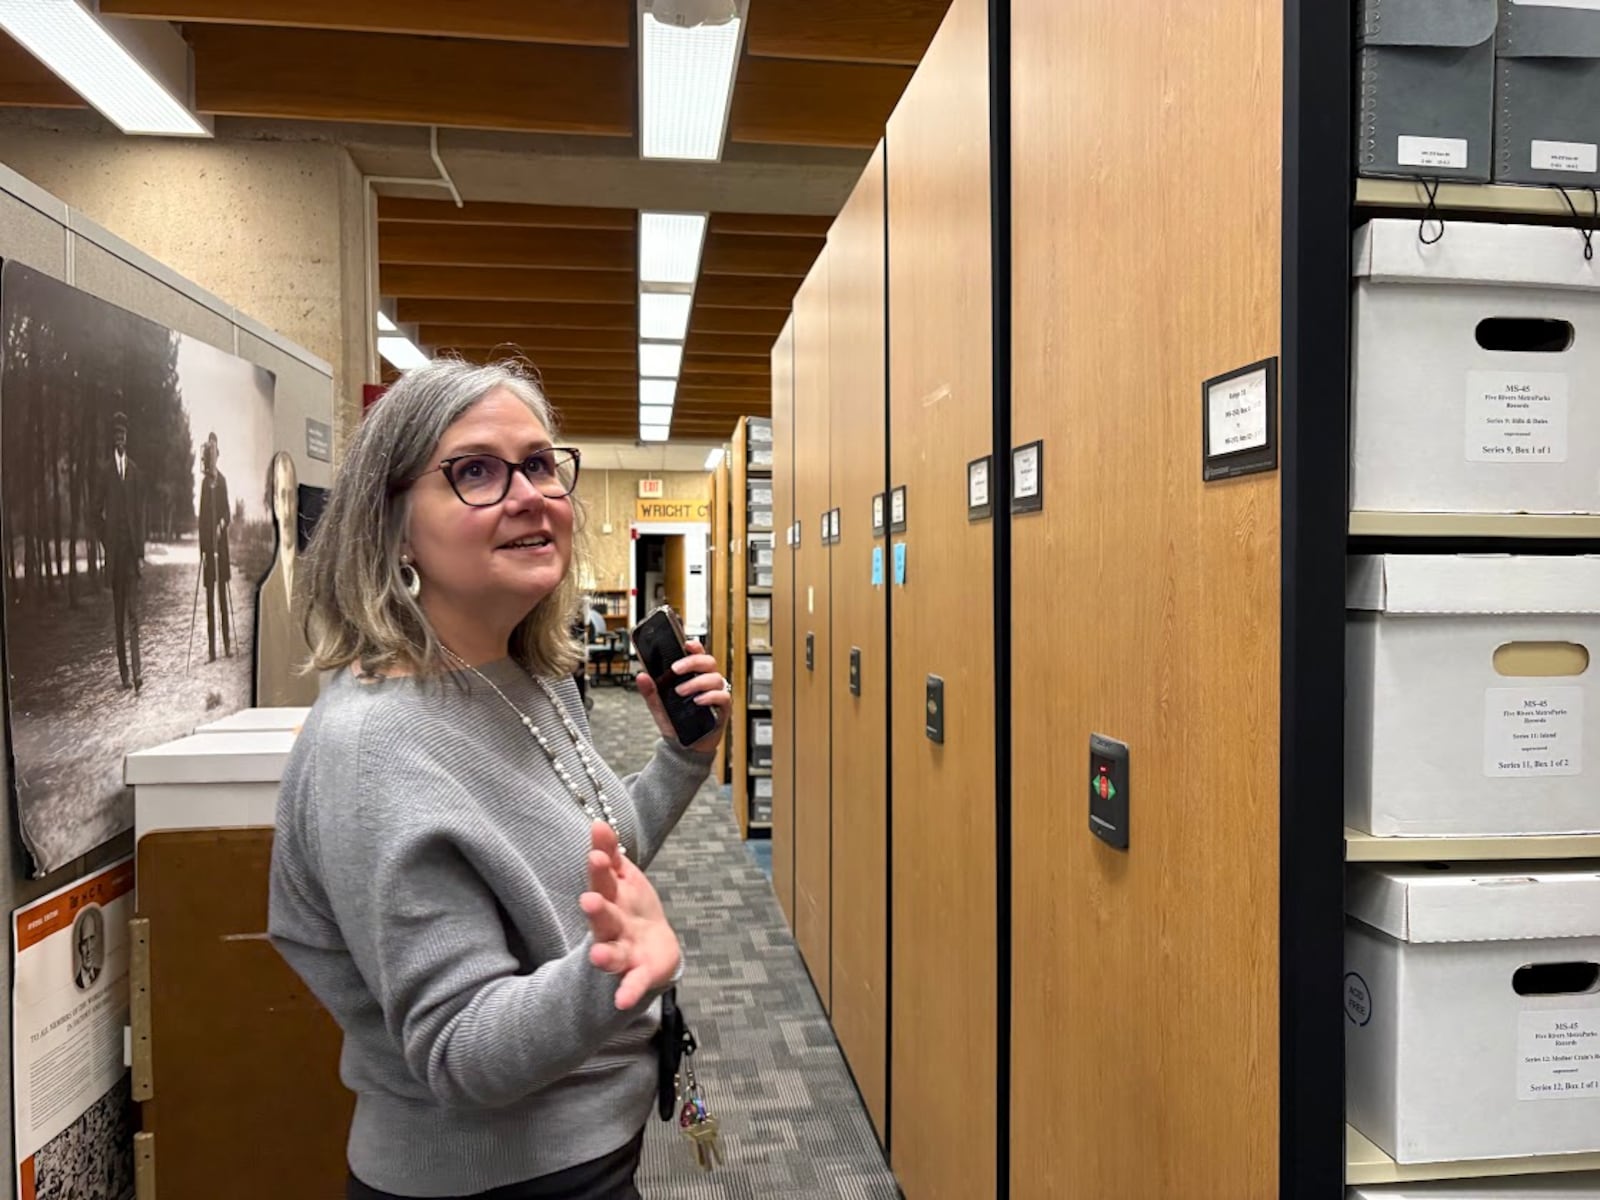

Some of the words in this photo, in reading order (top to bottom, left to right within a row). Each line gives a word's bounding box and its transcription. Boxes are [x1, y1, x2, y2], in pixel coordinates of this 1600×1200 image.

[1505, 384, 1531, 392] MS-45
[1482, 446, 1504, 454] Series
[1506, 446, 1513, 454] 9,
[644, 481, 659, 493] EXIT
[641, 504, 692, 517] WRIGHT
[1524, 700, 1548, 708] MS-45
[1498, 761, 1520, 769] Series
[1522, 761, 1533, 769] 11,
[1555, 1022, 1578, 1030] MS-45
[1530, 1084, 1552, 1092] Series
[1554, 1083, 1564, 1091] 12,
